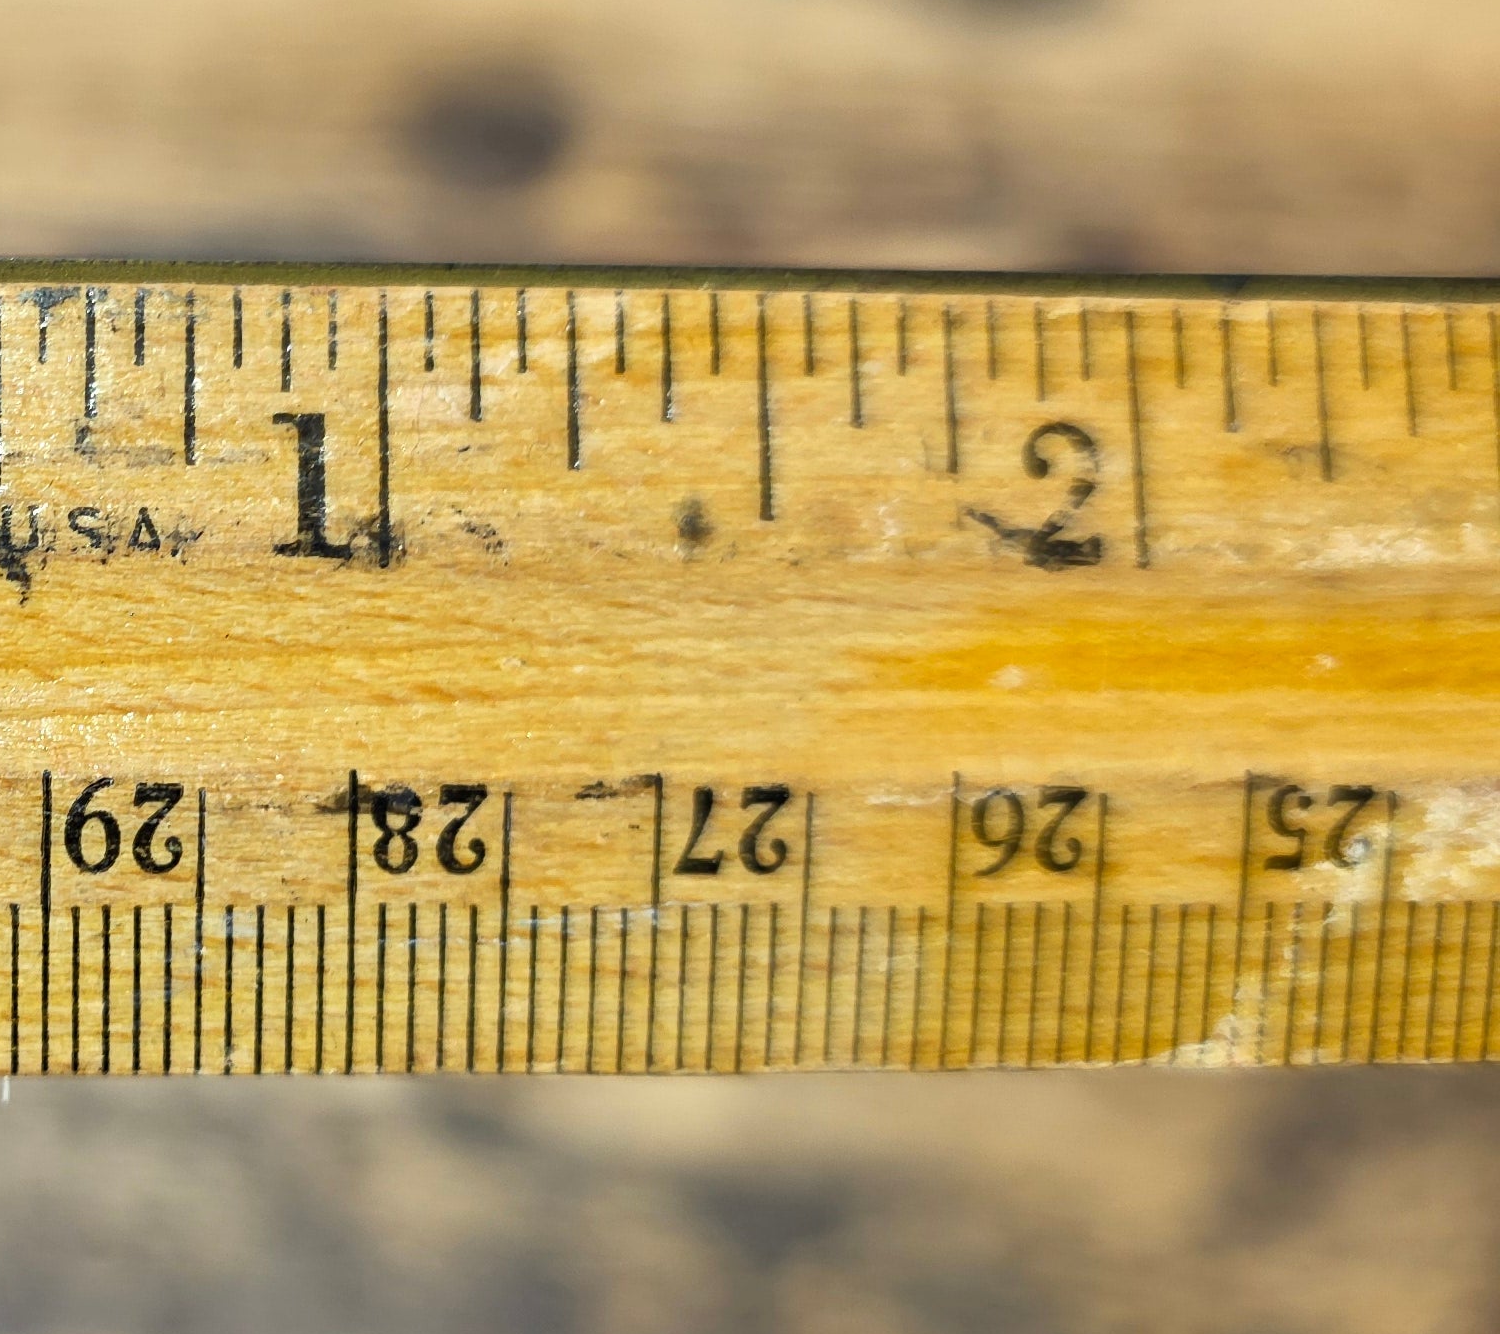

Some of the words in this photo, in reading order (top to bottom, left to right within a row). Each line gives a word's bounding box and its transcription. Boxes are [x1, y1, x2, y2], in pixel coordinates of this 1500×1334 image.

[272, 411, 353, 559] 1
[1004, 421, 1102, 569] 2
[64, 777, 184, 873] 29
[372, 783, 488, 875] 28
[673, 785, 790, 875] 27
[971, 784, 1088, 877] 26
[1264, 783, 1374, 871] 25
